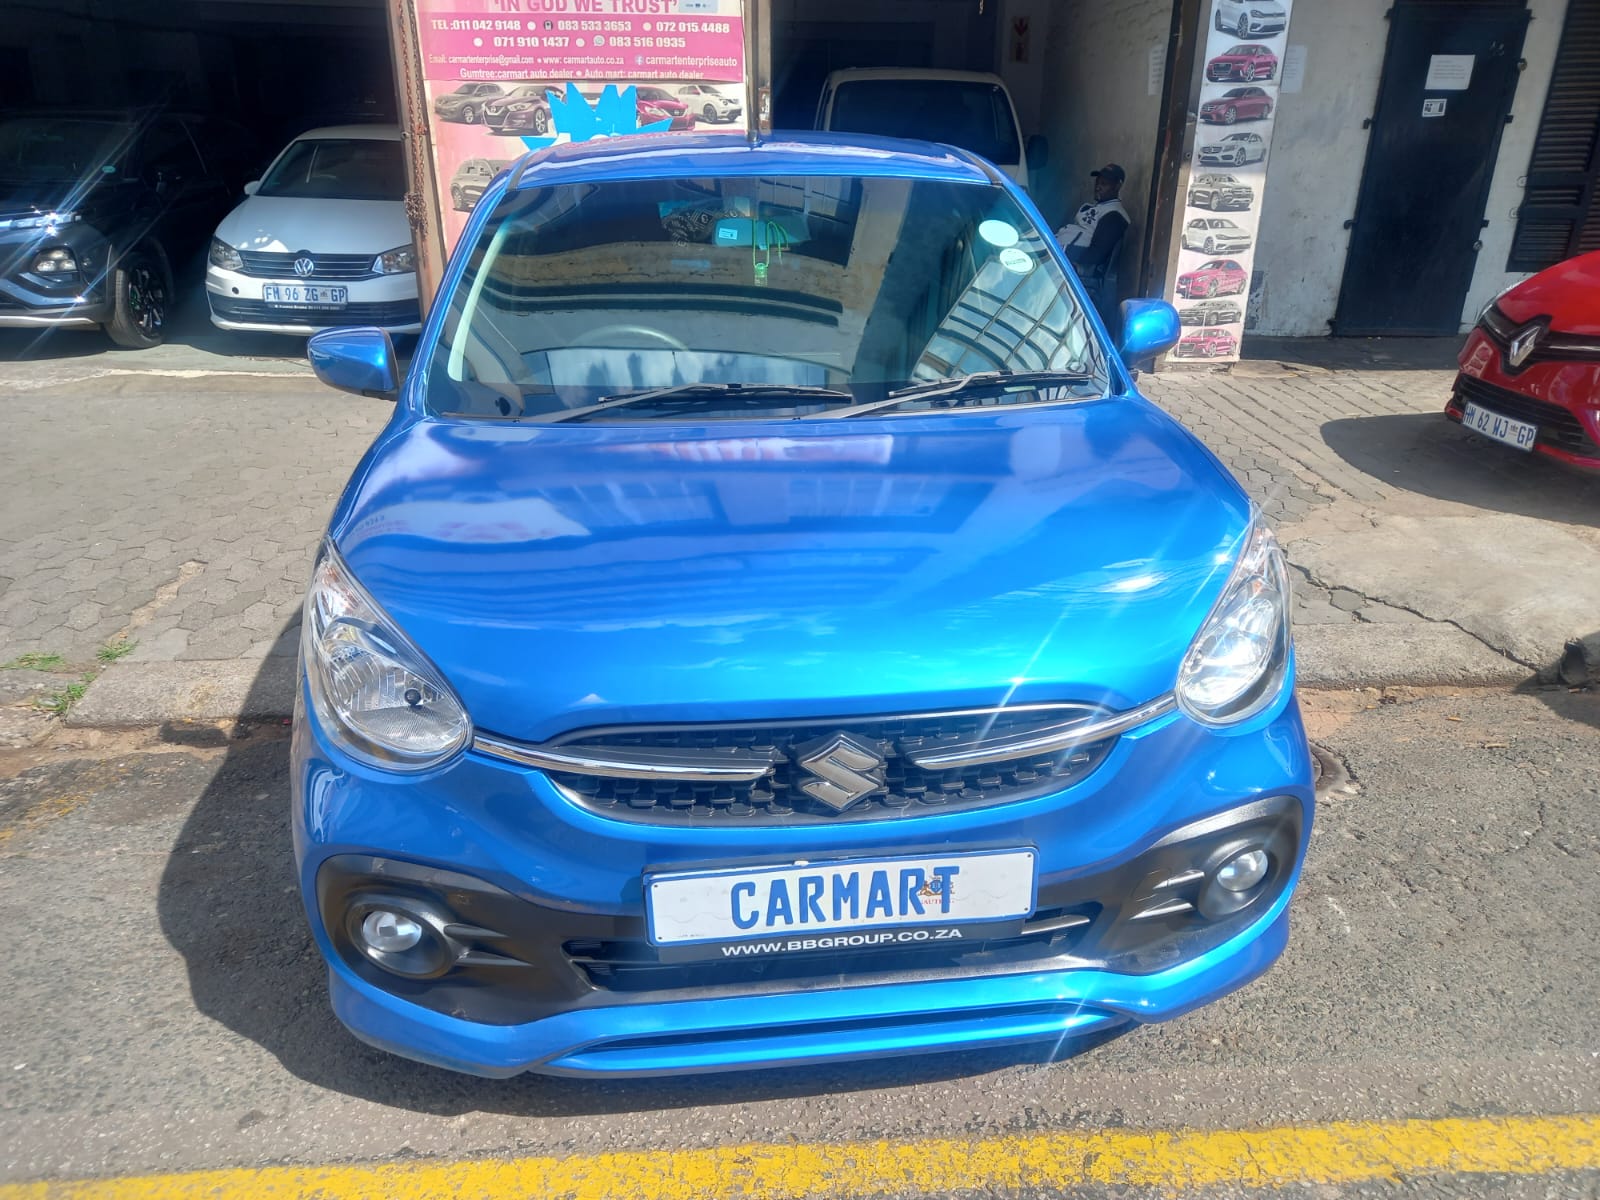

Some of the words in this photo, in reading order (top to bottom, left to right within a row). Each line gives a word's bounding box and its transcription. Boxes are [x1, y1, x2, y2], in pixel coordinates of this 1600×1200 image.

[527, 0, 568, 12] GOD
[575, 0, 604, 12] WE
[472, 20, 492, 31] 042
[495, 20, 521, 31] 9148
[558, 20, 578, 31] 083
[656, 21, 679, 33] 072
[493, 36, 514, 47] 071
[517, 36, 539, 48] 910
[542, 37, 570, 48] 1437
[609, 36, 632, 48] 083
[634, 36, 654, 48] 516
[655, 37, 687, 49] 0935
[529, 69, 548, 79] auto
[549, 69, 574, 79] dealer
[584, 69, 605, 79] Auto
[284, 287, 299, 301] 96
[303, 288, 319, 302] ZG
[330, 288, 346, 302] GP
[1477, 410, 1490, 432] 62
[1516, 425, 1535, 447] GP
[730, 866, 961, 930] CARMART
[721, 928, 964, 957] WWW.BBGROUP.CO.ZA
